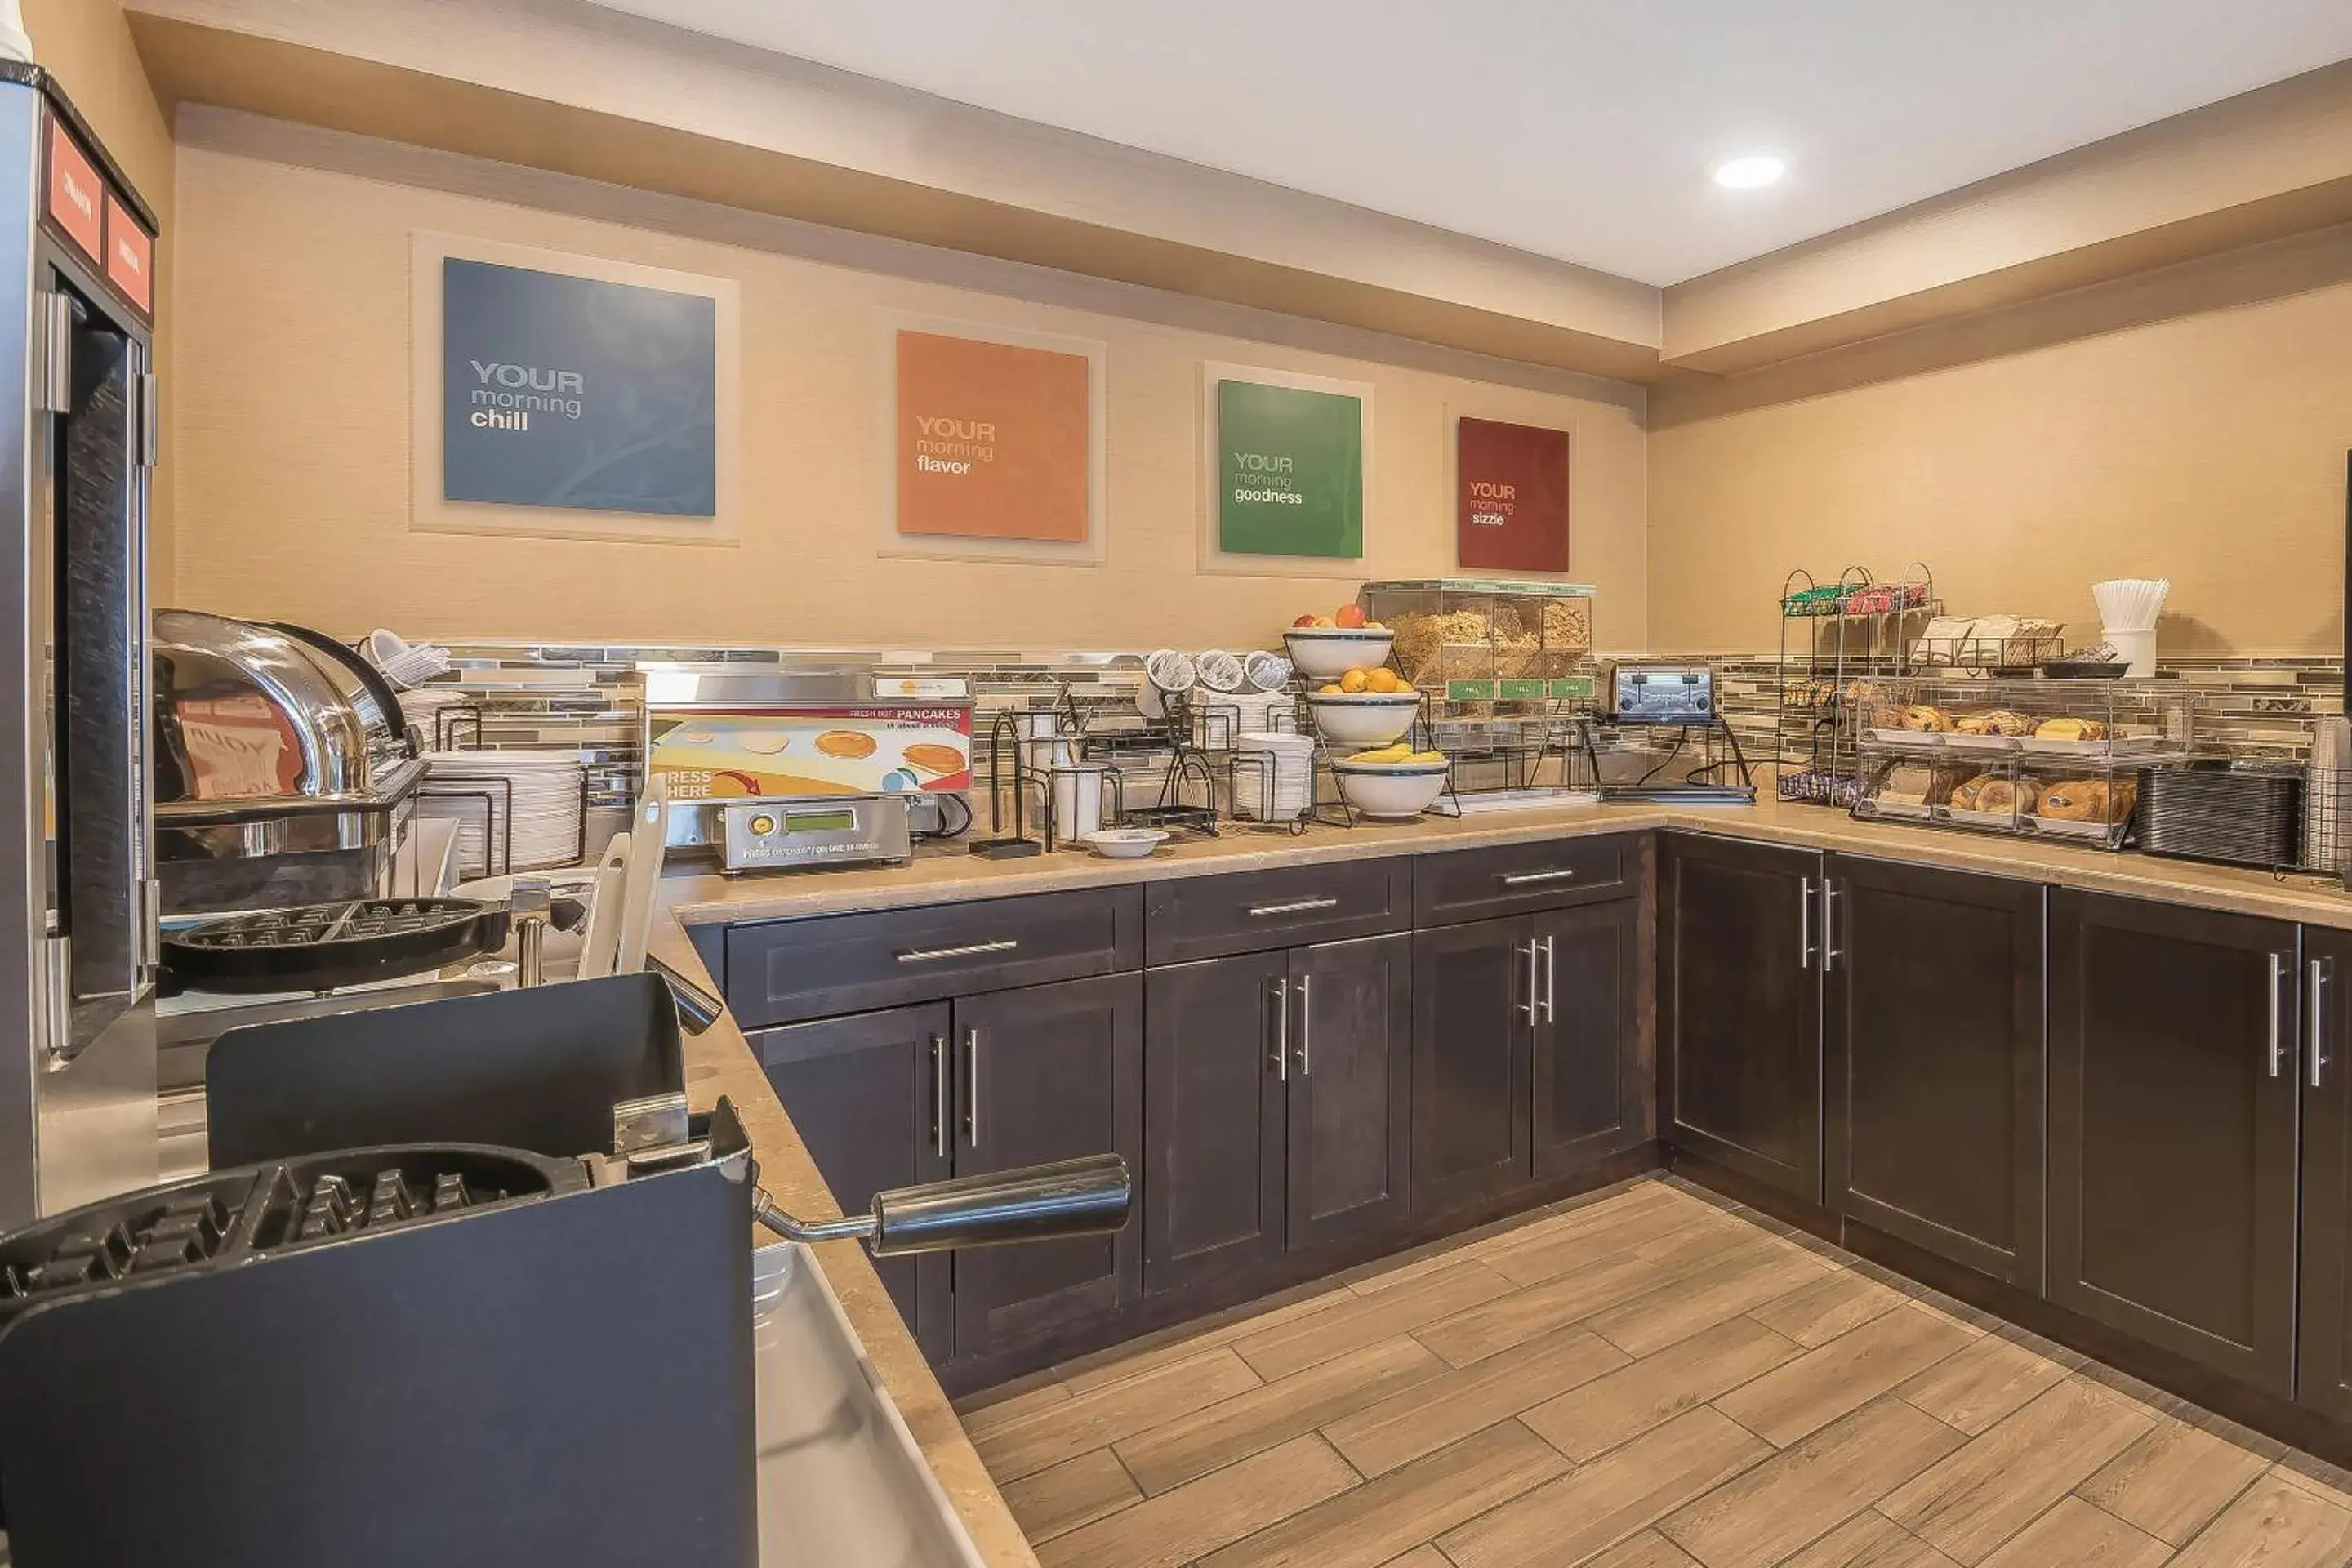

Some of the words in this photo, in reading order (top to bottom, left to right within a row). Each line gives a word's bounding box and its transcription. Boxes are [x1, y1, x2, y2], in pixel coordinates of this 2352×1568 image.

[470, 359, 584, 394] YOUR
[471, 390, 581, 420] morning
[470, 408, 528, 430] chill
[916, 415, 995, 442] YOUR
[916, 439, 993, 462] morning
[916, 455, 971, 474] flavor
[1233, 452, 1293, 473] YOUR
[1235, 473, 1291, 491] morning
[1470, 482, 1515, 499] YOUR
[1235, 488, 1303, 504] goodness
[897, 710, 961, 719] PANCAKES
[666, 770, 711, 784] RESS
[666, 784, 712, 797] HERE
